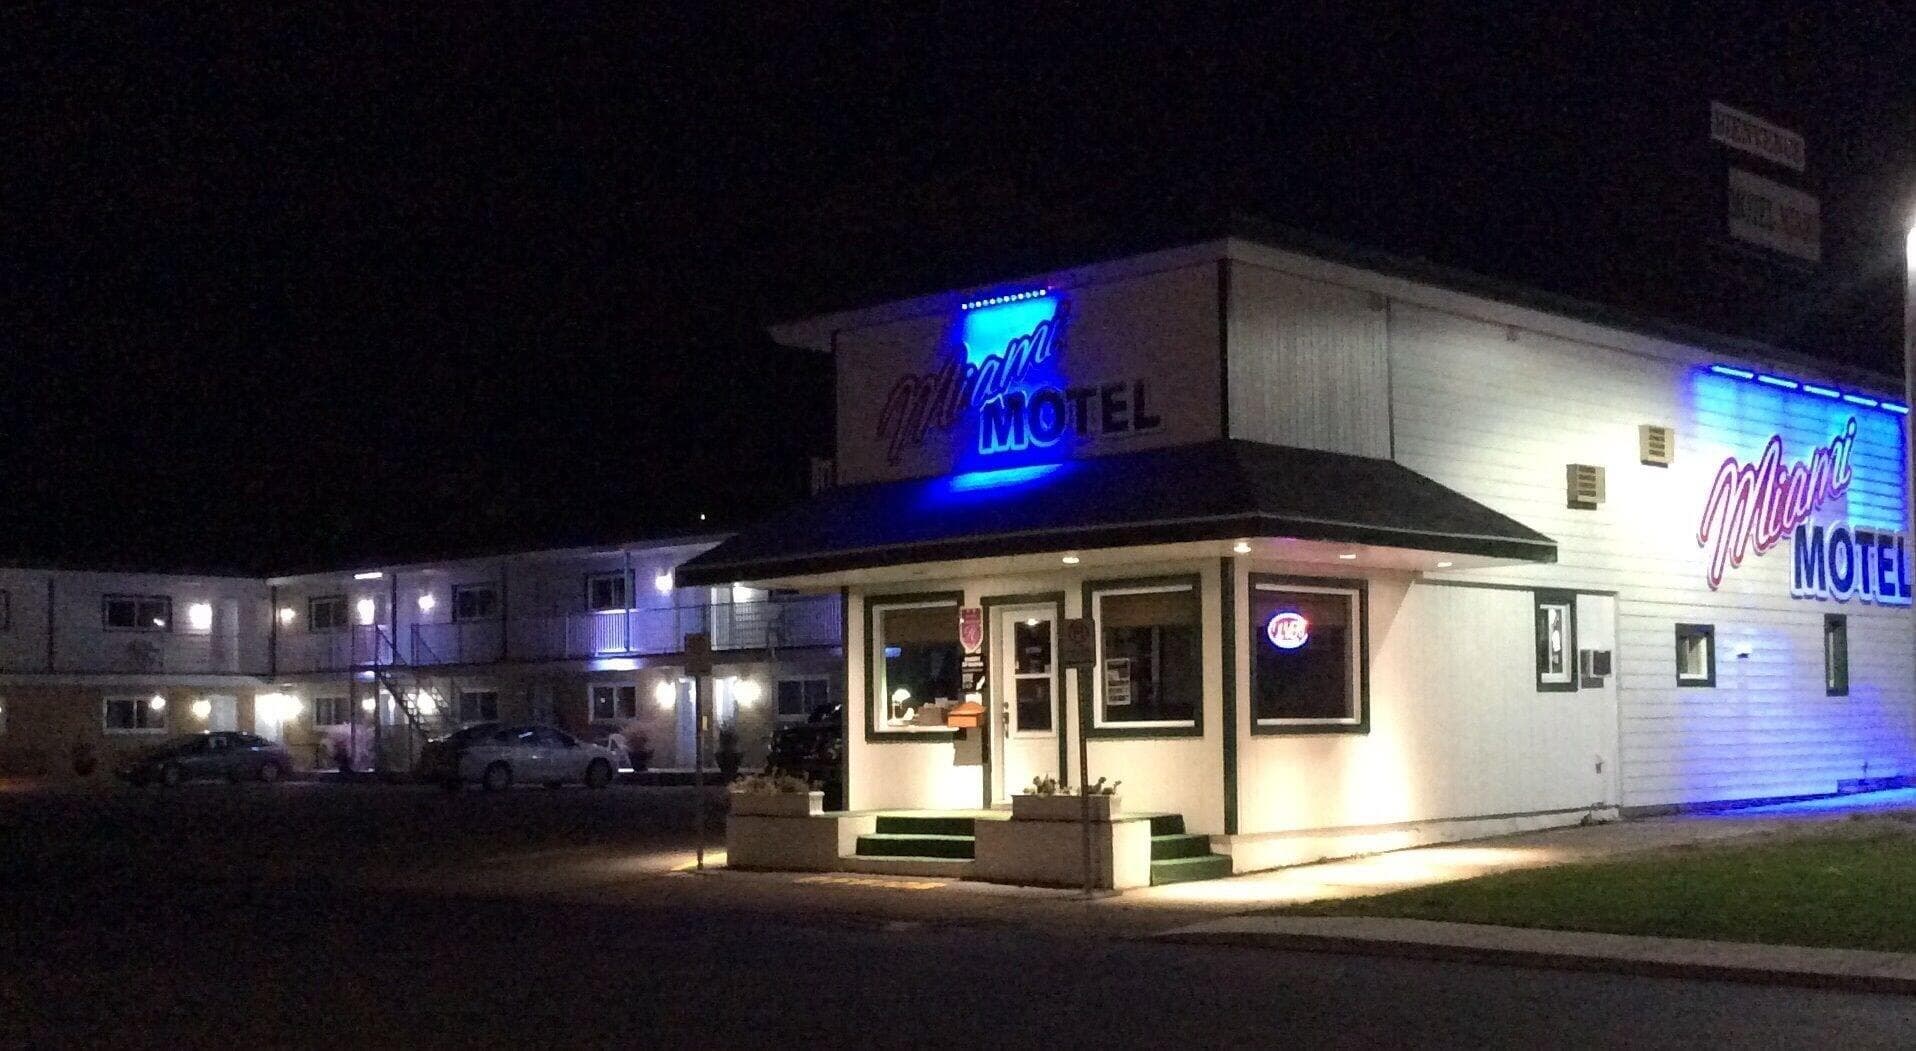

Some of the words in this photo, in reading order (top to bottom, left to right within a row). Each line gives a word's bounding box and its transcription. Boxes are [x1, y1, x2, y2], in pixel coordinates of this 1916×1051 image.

[877, 302, 1066, 467] Miami
[980, 380, 1161, 453] MOTEL
[1699, 417, 1857, 590] Miami
[1792, 525, 1912, 604] MOTEL
